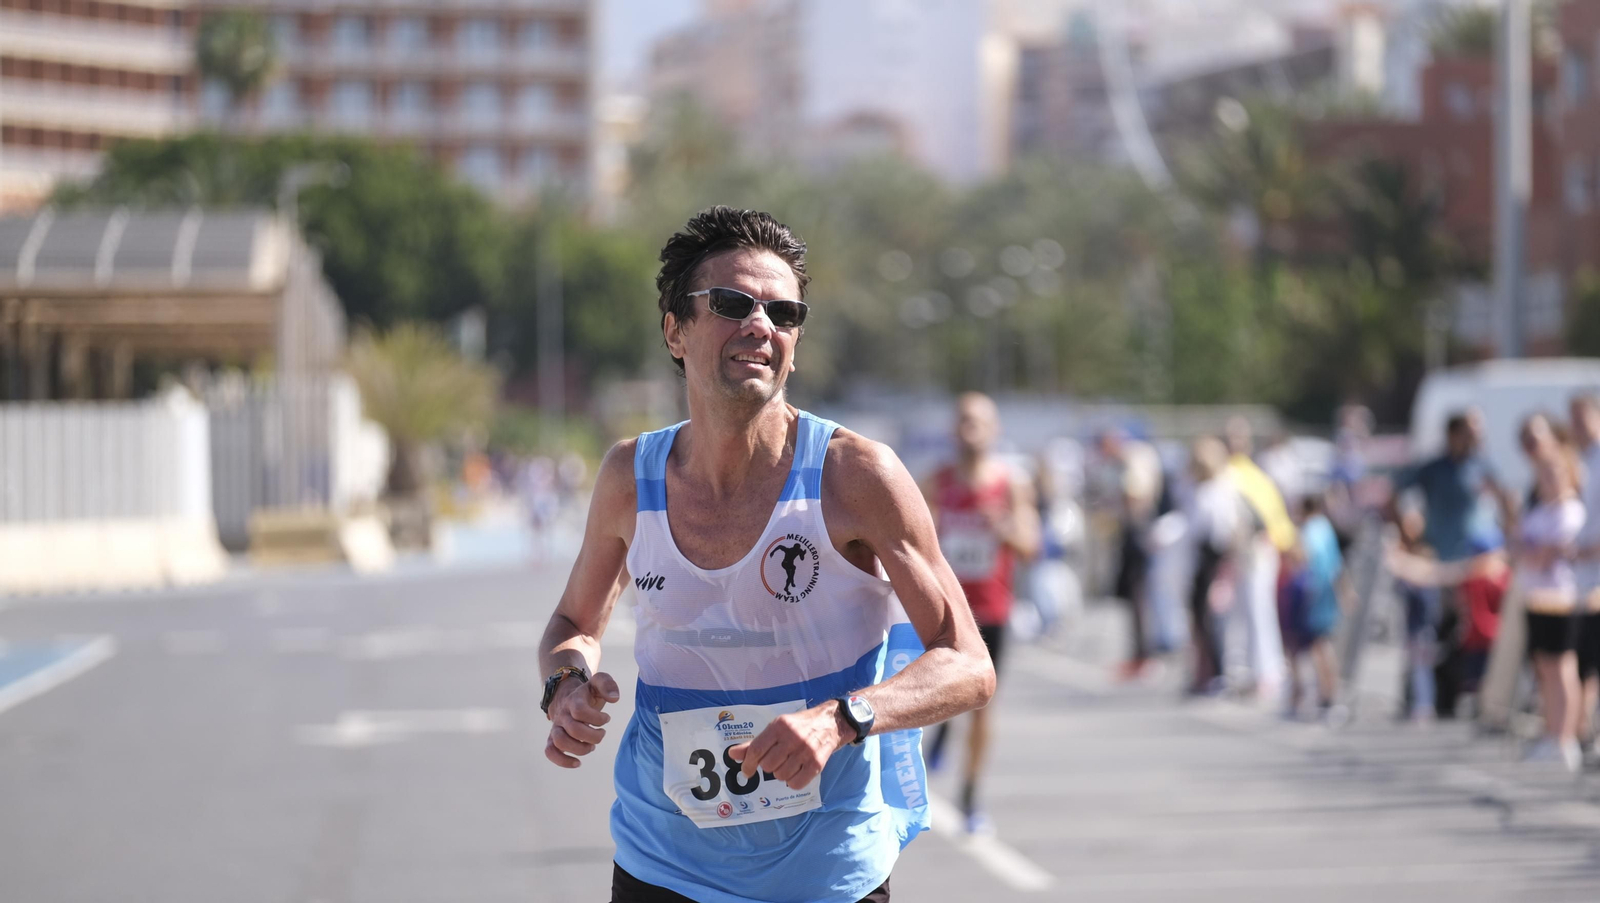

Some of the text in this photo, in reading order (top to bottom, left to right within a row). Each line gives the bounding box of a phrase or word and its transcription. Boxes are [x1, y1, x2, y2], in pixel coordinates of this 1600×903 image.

[774, 533, 820, 603] MELILLERO TRAINING TEAM
[715, 721, 754, 731] 10km20
[890, 652, 924, 810] MELILO
[688, 743, 789, 801] 38
